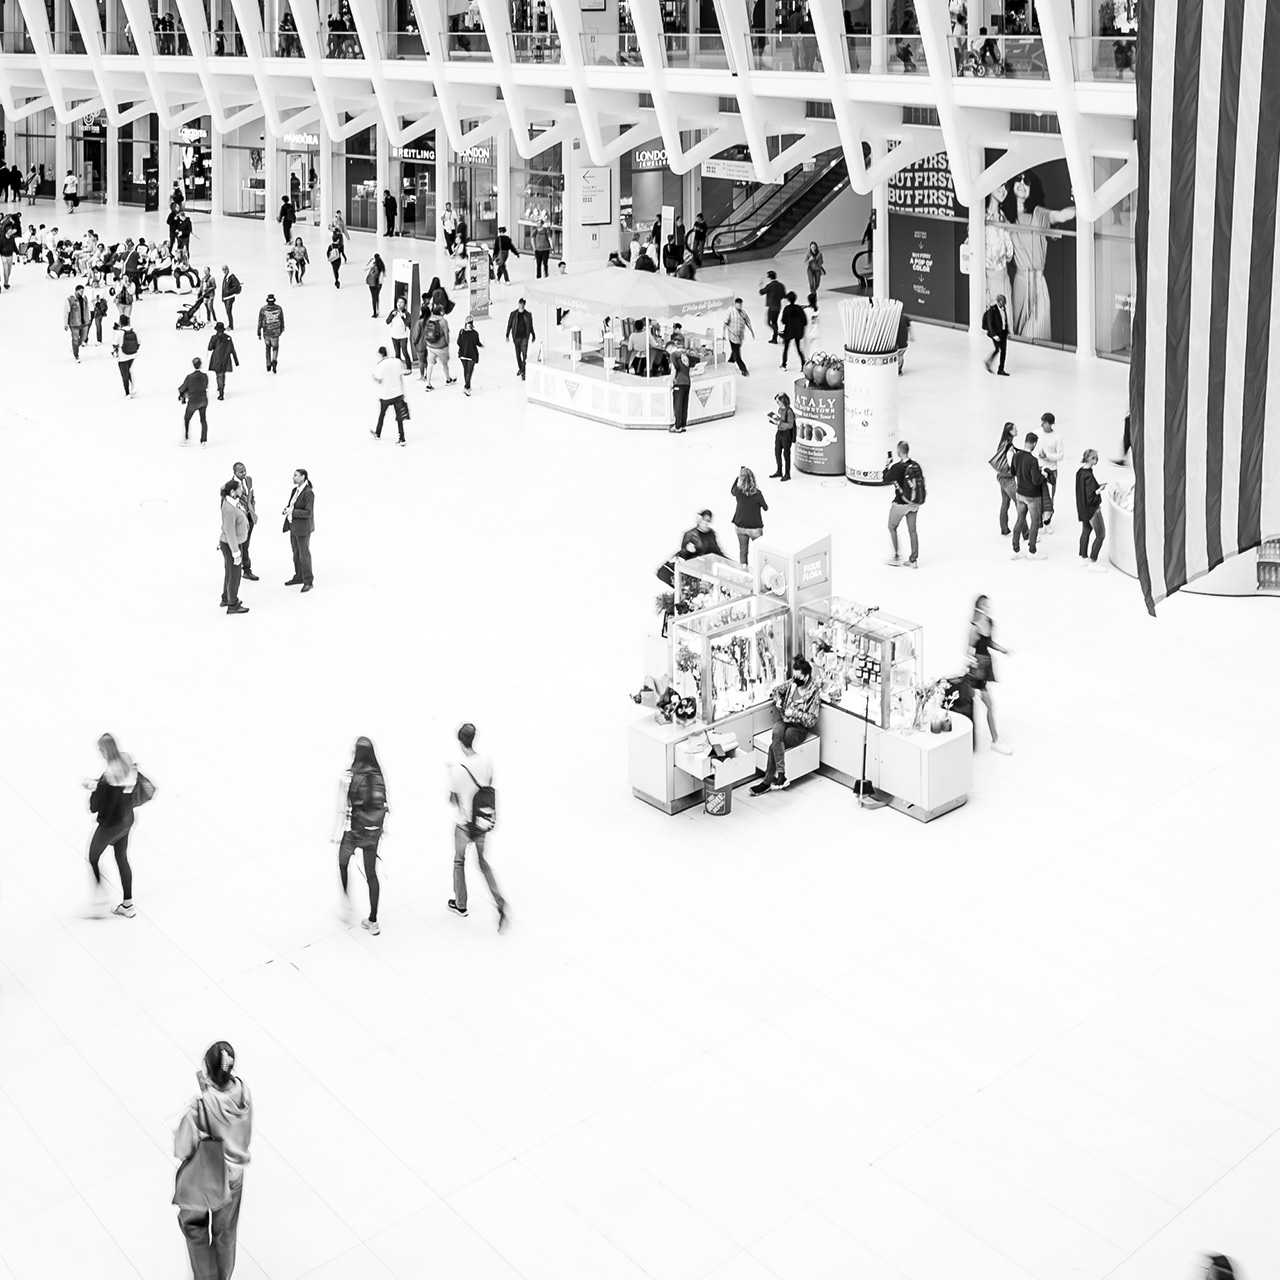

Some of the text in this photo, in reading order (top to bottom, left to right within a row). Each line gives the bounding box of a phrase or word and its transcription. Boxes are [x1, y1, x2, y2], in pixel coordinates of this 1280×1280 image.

[392, 148, 435, 160] BREITLING
[636, 149, 668, 162] LONDO
[888, 188, 955, 207] BUT FIRST
[913, 264, 930, 272] COLOR
[795, 394, 836, 408] ATALY
